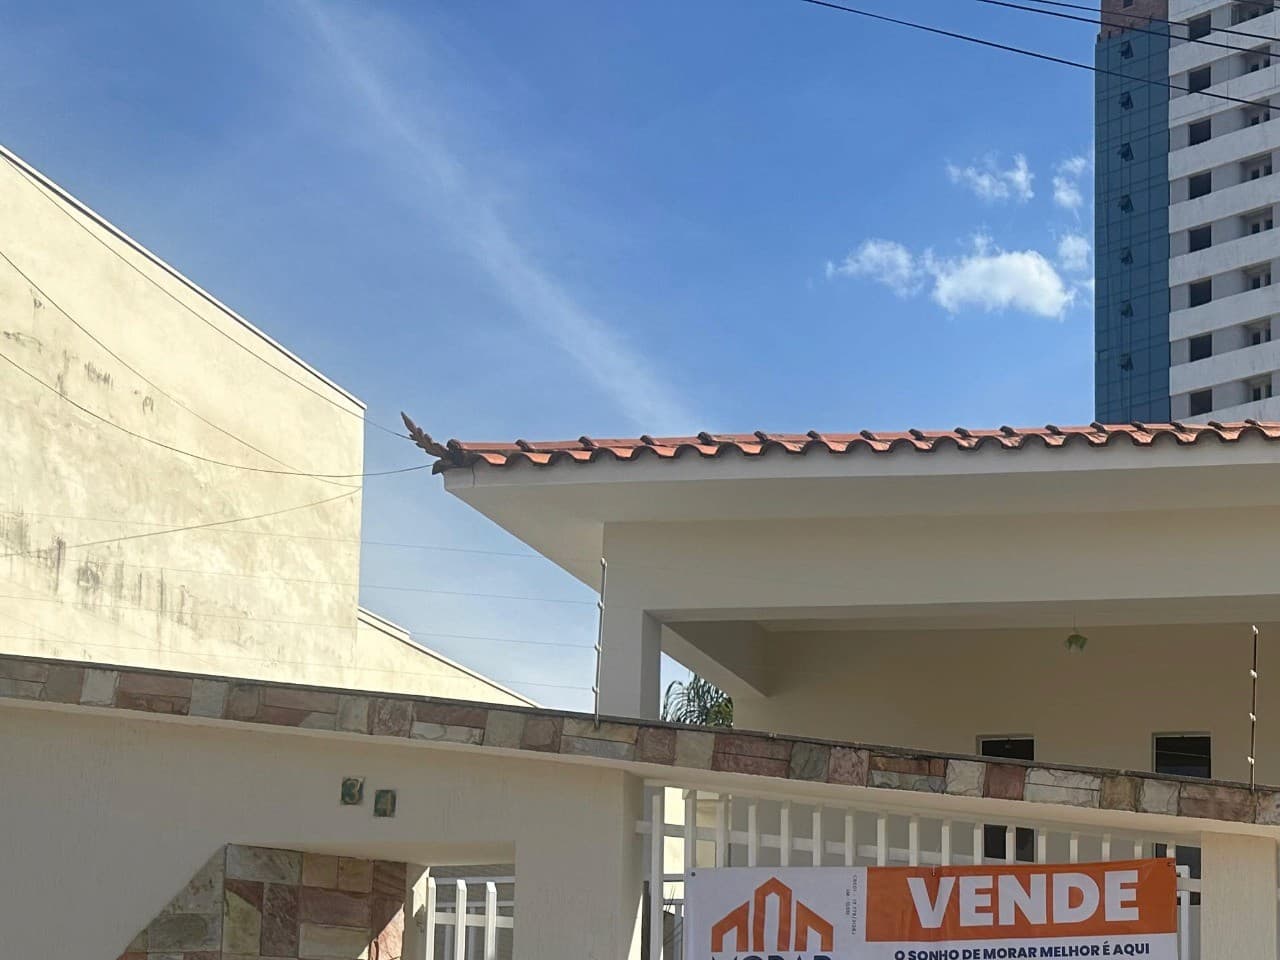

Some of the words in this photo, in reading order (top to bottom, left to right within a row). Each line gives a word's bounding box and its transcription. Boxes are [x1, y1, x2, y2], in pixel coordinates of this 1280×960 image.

[906, 869, 1139, 929] VENDE
[894, 950, 905, 960] O
[908, 949, 960, 960] SONHO
[962, 949, 981, 960] DE
[983, 947, 1037, 960] MORAR
[1040, 944, 1100, 958] MELHOR
[1102, 941, 1110, 956] É
[1113, 943, 1150, 955] AQUI
